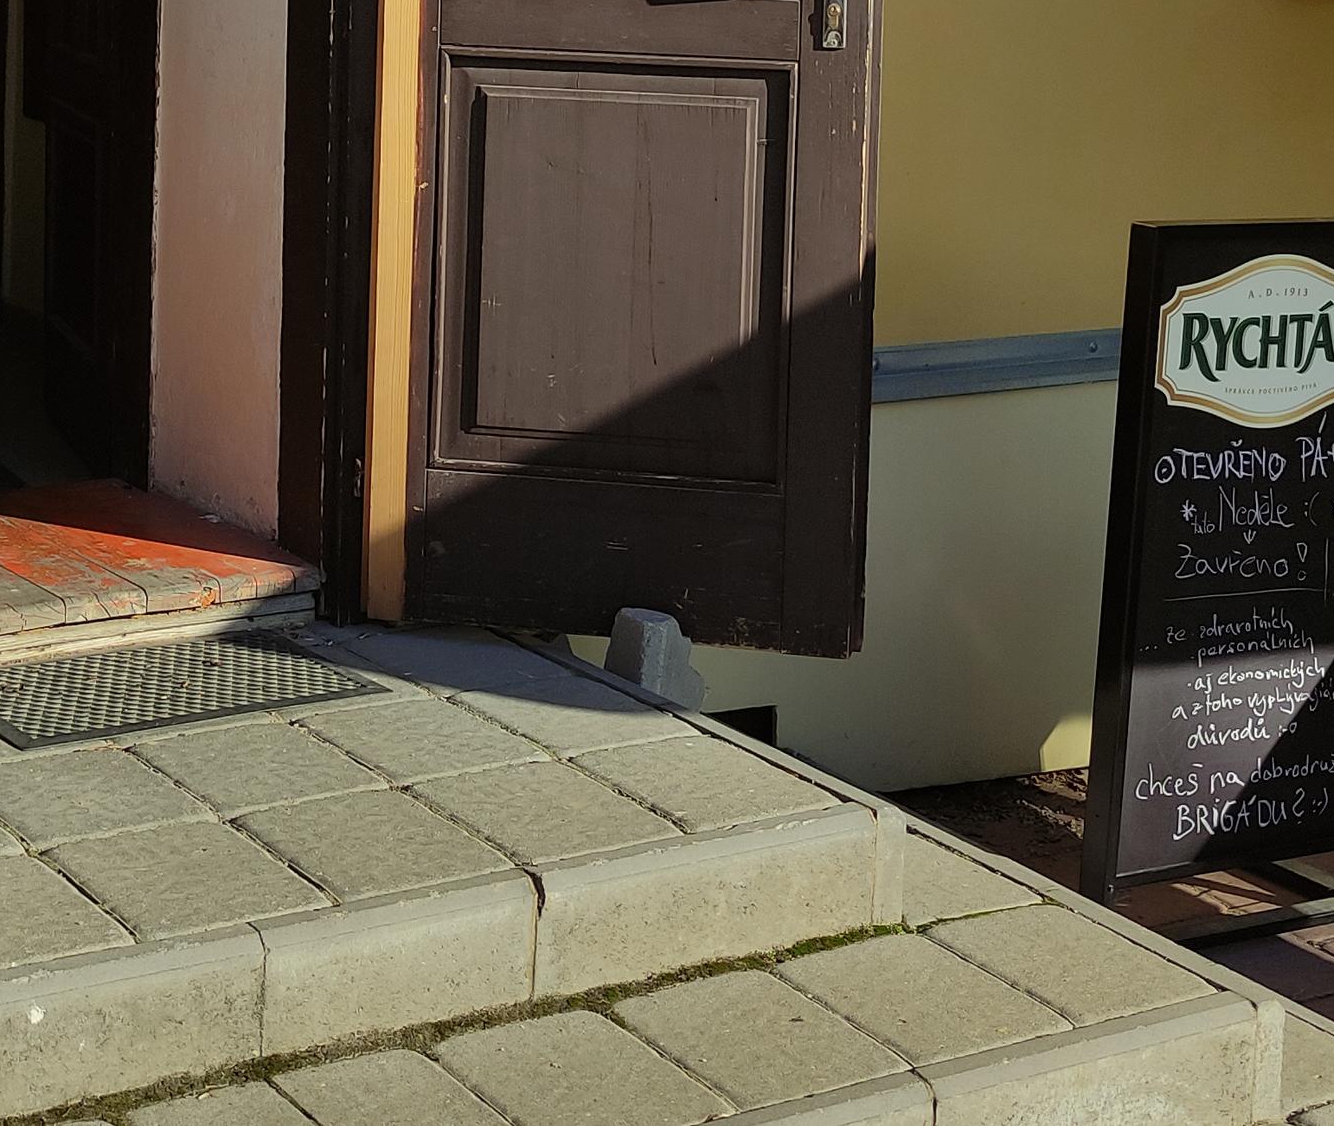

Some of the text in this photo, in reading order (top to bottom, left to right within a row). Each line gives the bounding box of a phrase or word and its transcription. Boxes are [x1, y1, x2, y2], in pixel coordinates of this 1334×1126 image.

[1154, 439, 1286, 483] OTEVŘENO
[1218, 485, 1295, 531] Neděle
[1187, 718, 1270, 749] důvodů
[1135, 762, 1204, 800] chceš
[1210, 770, 1246, 793] na
